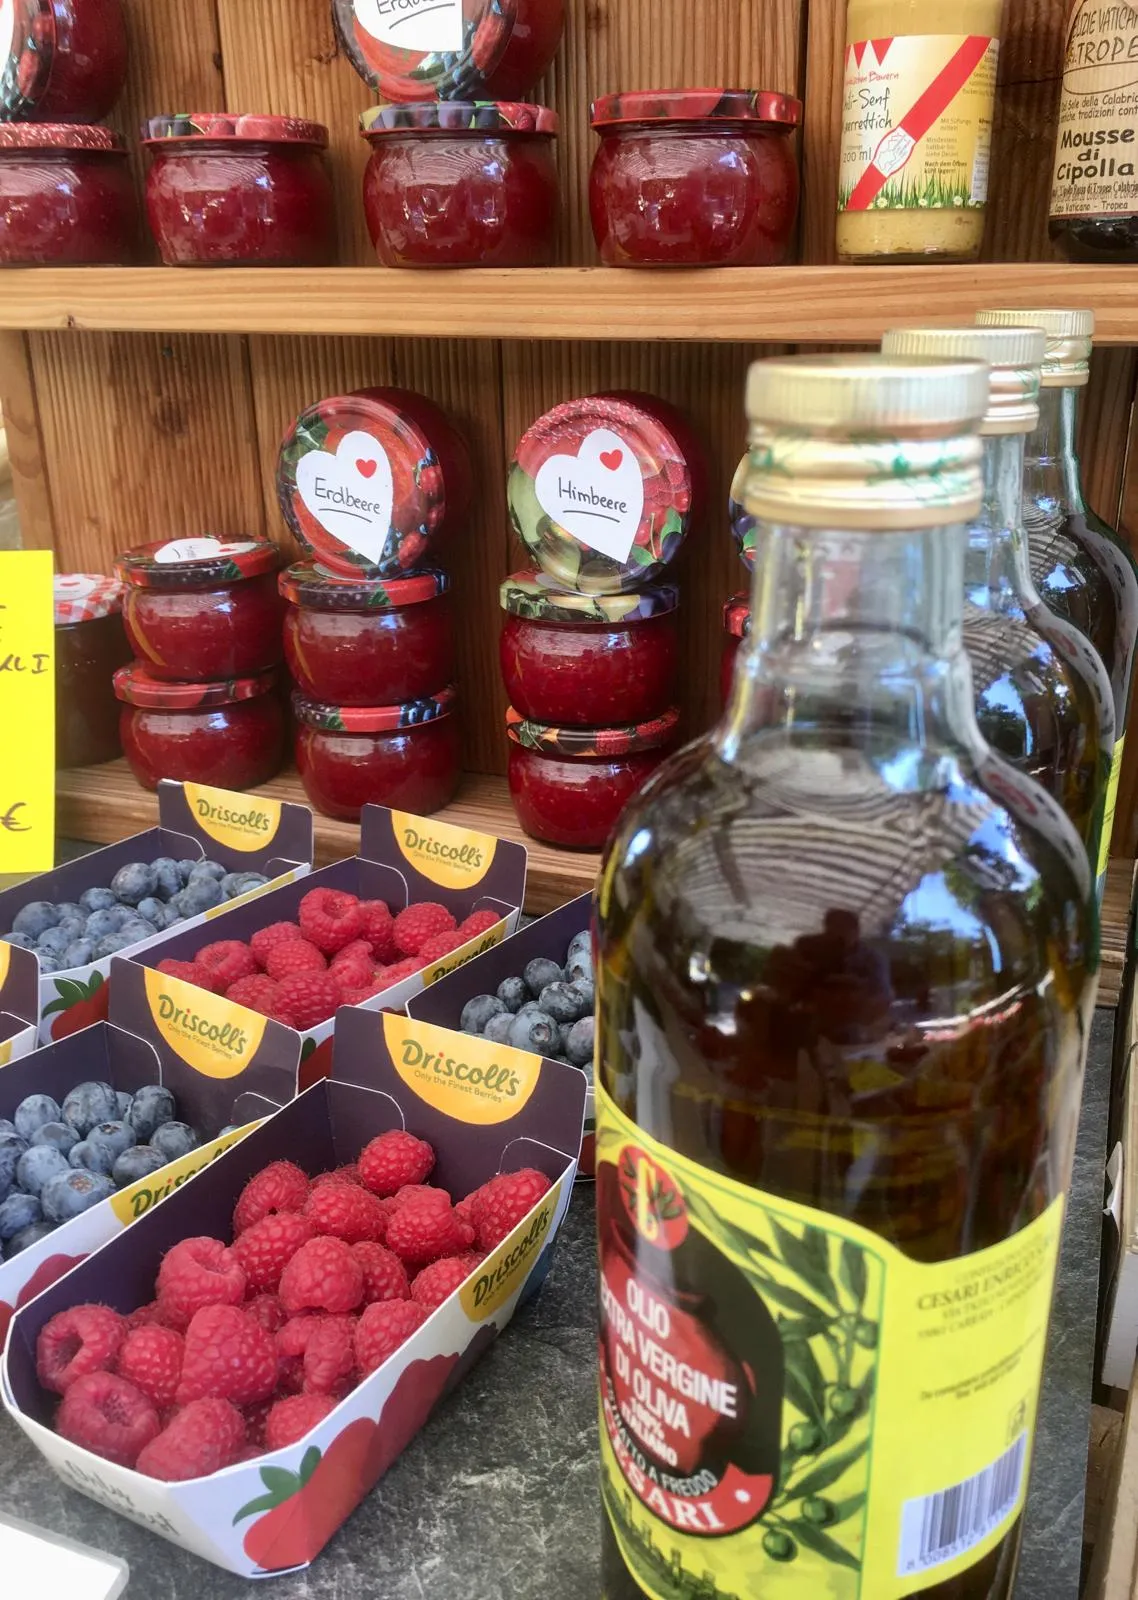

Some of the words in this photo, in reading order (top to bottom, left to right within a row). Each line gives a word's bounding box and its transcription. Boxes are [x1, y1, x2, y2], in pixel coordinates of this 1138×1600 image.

[1078, 105, 1115, 120] tradizioni
[1082, 95, 1099, 108] della
[859, 147, 872, 161] ml
[1060, 128, 1136, 150] Mousse
[1077, 147, 1100, 162] di
[1056, 157, 1135, 185] Cipolla
[1101, 200, 1129, 213] Tropea
[313, 477, 381, 516] Erdbeere
[558, 477, 628, 514] Himbeere
[196, 798, 271, 831] Driscoll's
[403, 828, 484, 868] Driscoll's
[158, 993, 248, 1055] Driscoll's
[400, 1038, 520, 1097] Driscoll's
[413, 1068, 432, 1083] Only
[433, 1074, 447, 1087] the
[447, 1079, 473, 1094] Finest
[473, 1086, 503, 1104] Berries
[472, 1207, 550, 1308] Driscoll's
[626, 1277, 671, 1340] OLIO
[615, 1342, 630, 1386] DI
[632, 1367, 691, 1439] OLIVA
[637, 1331, 738, 1419] VERGINE
